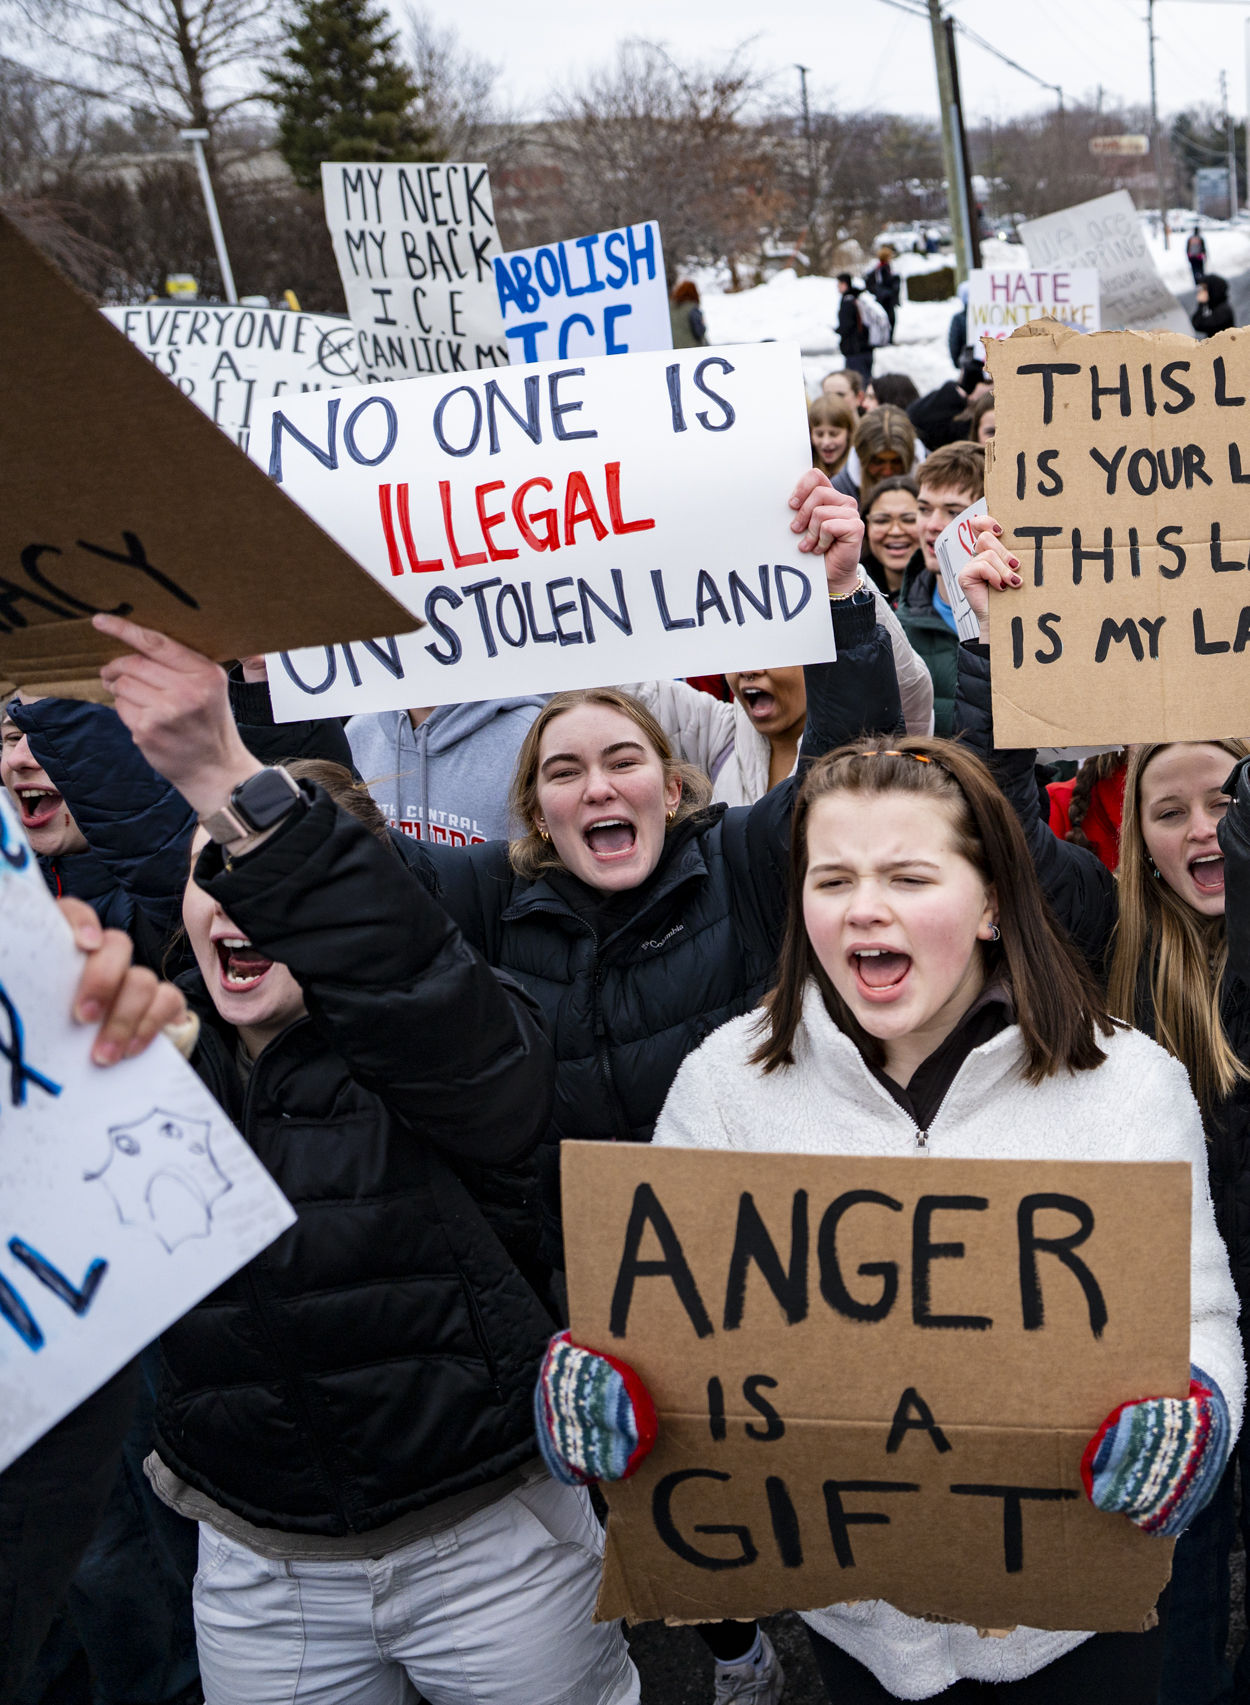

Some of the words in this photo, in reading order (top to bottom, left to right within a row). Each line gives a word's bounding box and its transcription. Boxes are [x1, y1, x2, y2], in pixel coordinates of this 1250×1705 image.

[342, 167, 383, 224] MY
[398, 165, 494, 227] NECK
[345, 229, 388, 279] MY
[401, 228, 494, 282] BACK
[494, 224, 656, 319] ABOLISH
[990, 272, 1071, 303] HATE
[124, 310, 311, 354] EVERYONE
[358, 330, 407, 369] CAN
[410, 337, 467, 373] LICK
[210, 351, 242, 381] A
[1015, 360, 1196, 426] THIS
[269, 396, 399, 484] NO
[433, 367, 598, 458] ONE
[665, 356, 736, 434] IS
[1016, 448, 1065, 500] IS
[1089, 442, 1213, 497] YOUR
[378, 461, 656, 576] ILLEGAL
[1012, 524, 1188, 587] THIS
[424, 567, 632, 666] STOLEN
[650, 564, 812, 632] LAND
[1011, 612, 1064, 669] IS
[1094, 615, 1167, 663] MY
[609, 1182, 1108, 1341] ANGER
[707, 1374, 785, 1443] IS
[886, 1387, 952, 1453] A
[652, 1468, 1082, 1574] GIFT
